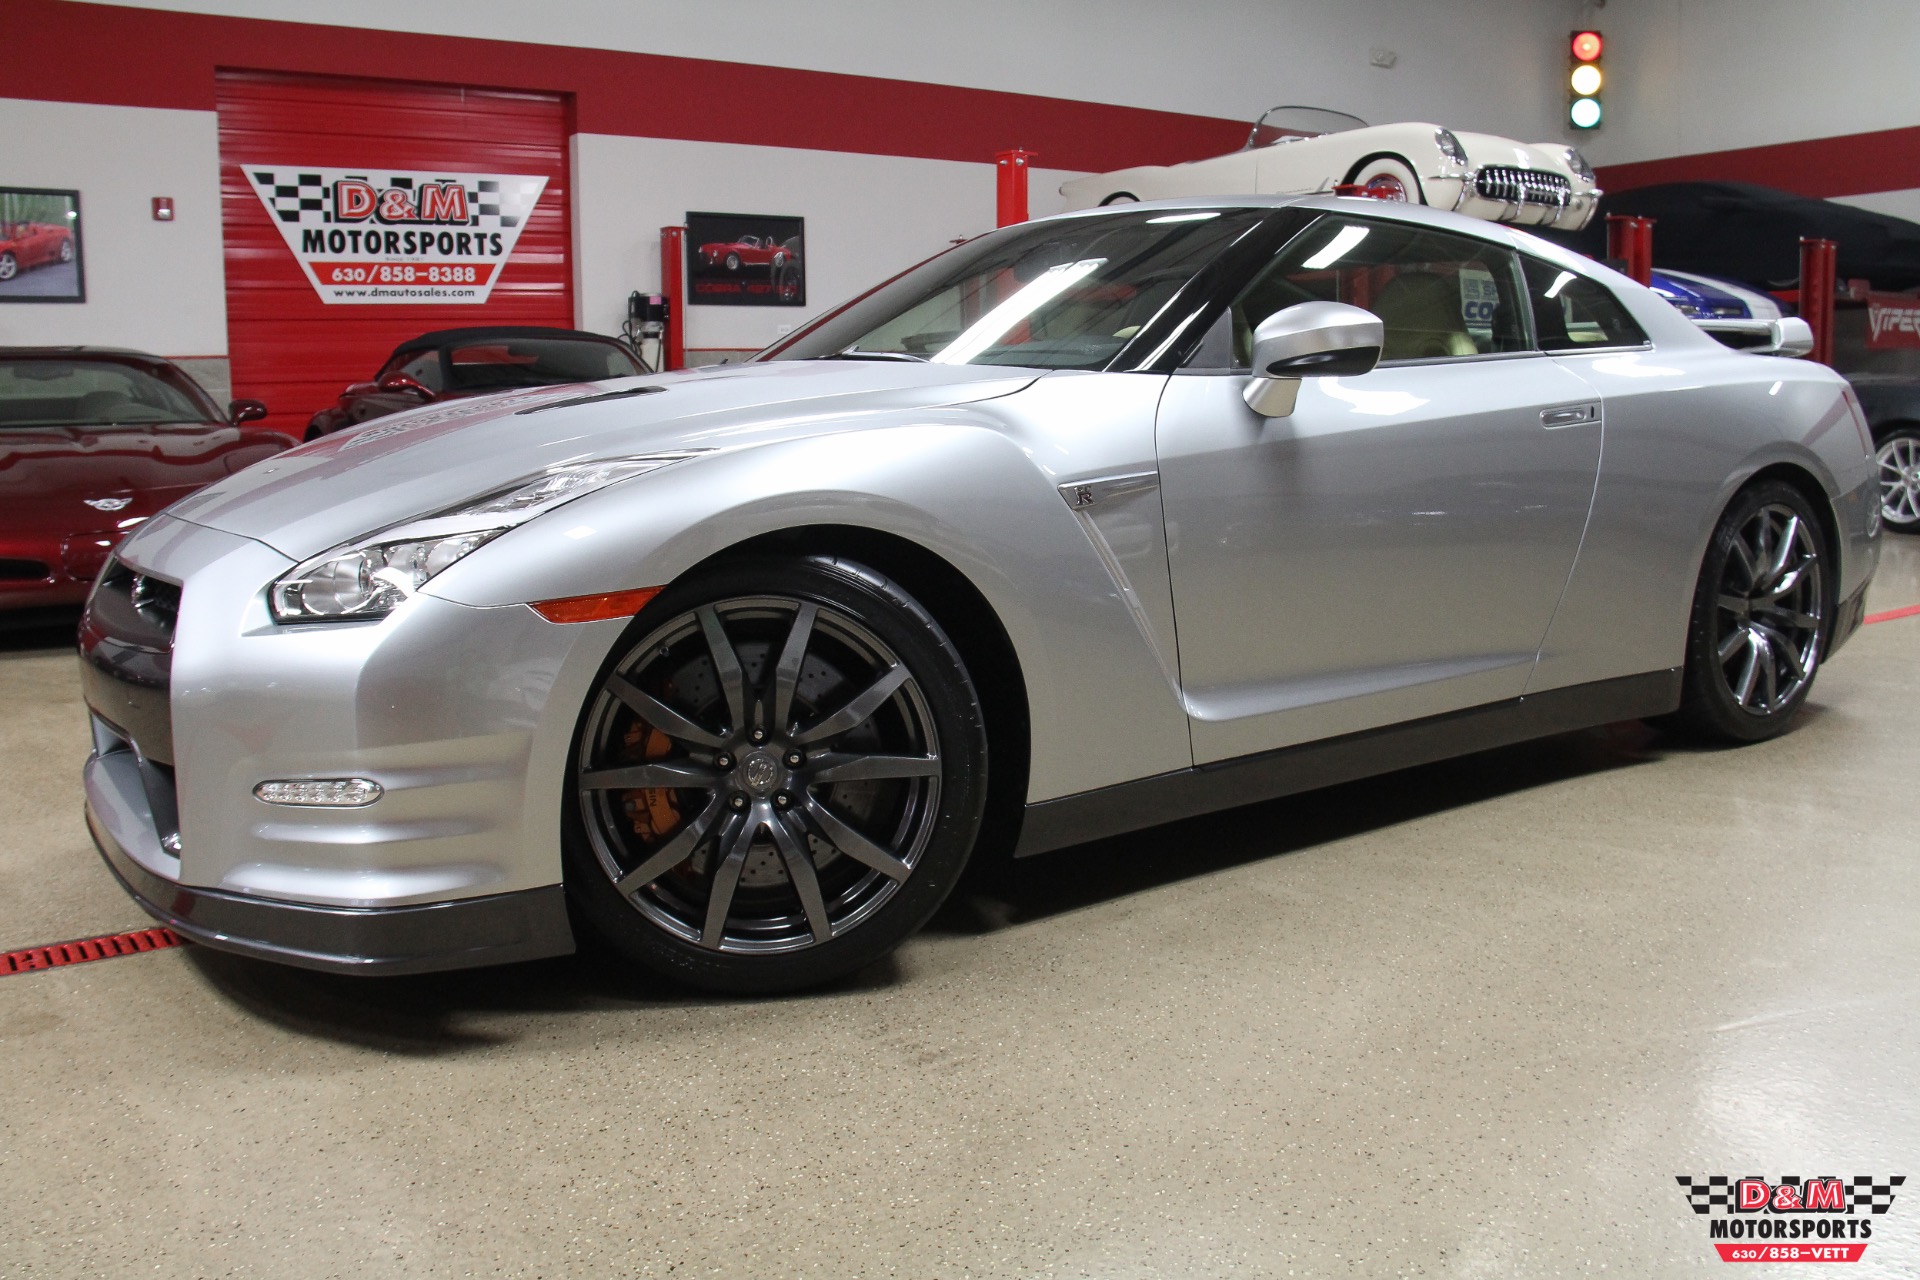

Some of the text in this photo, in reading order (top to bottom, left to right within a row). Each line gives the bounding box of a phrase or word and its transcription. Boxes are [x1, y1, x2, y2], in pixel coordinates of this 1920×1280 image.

[334, 178, 470, 225] D&M
[302, 228, 503, 257] MOTORSPORTS
[331, 265, 476, 284] 630/858-8388
[333, 287, 475, 298] www.dmautosales.com
[1465, 301, 1494, 320] CO
